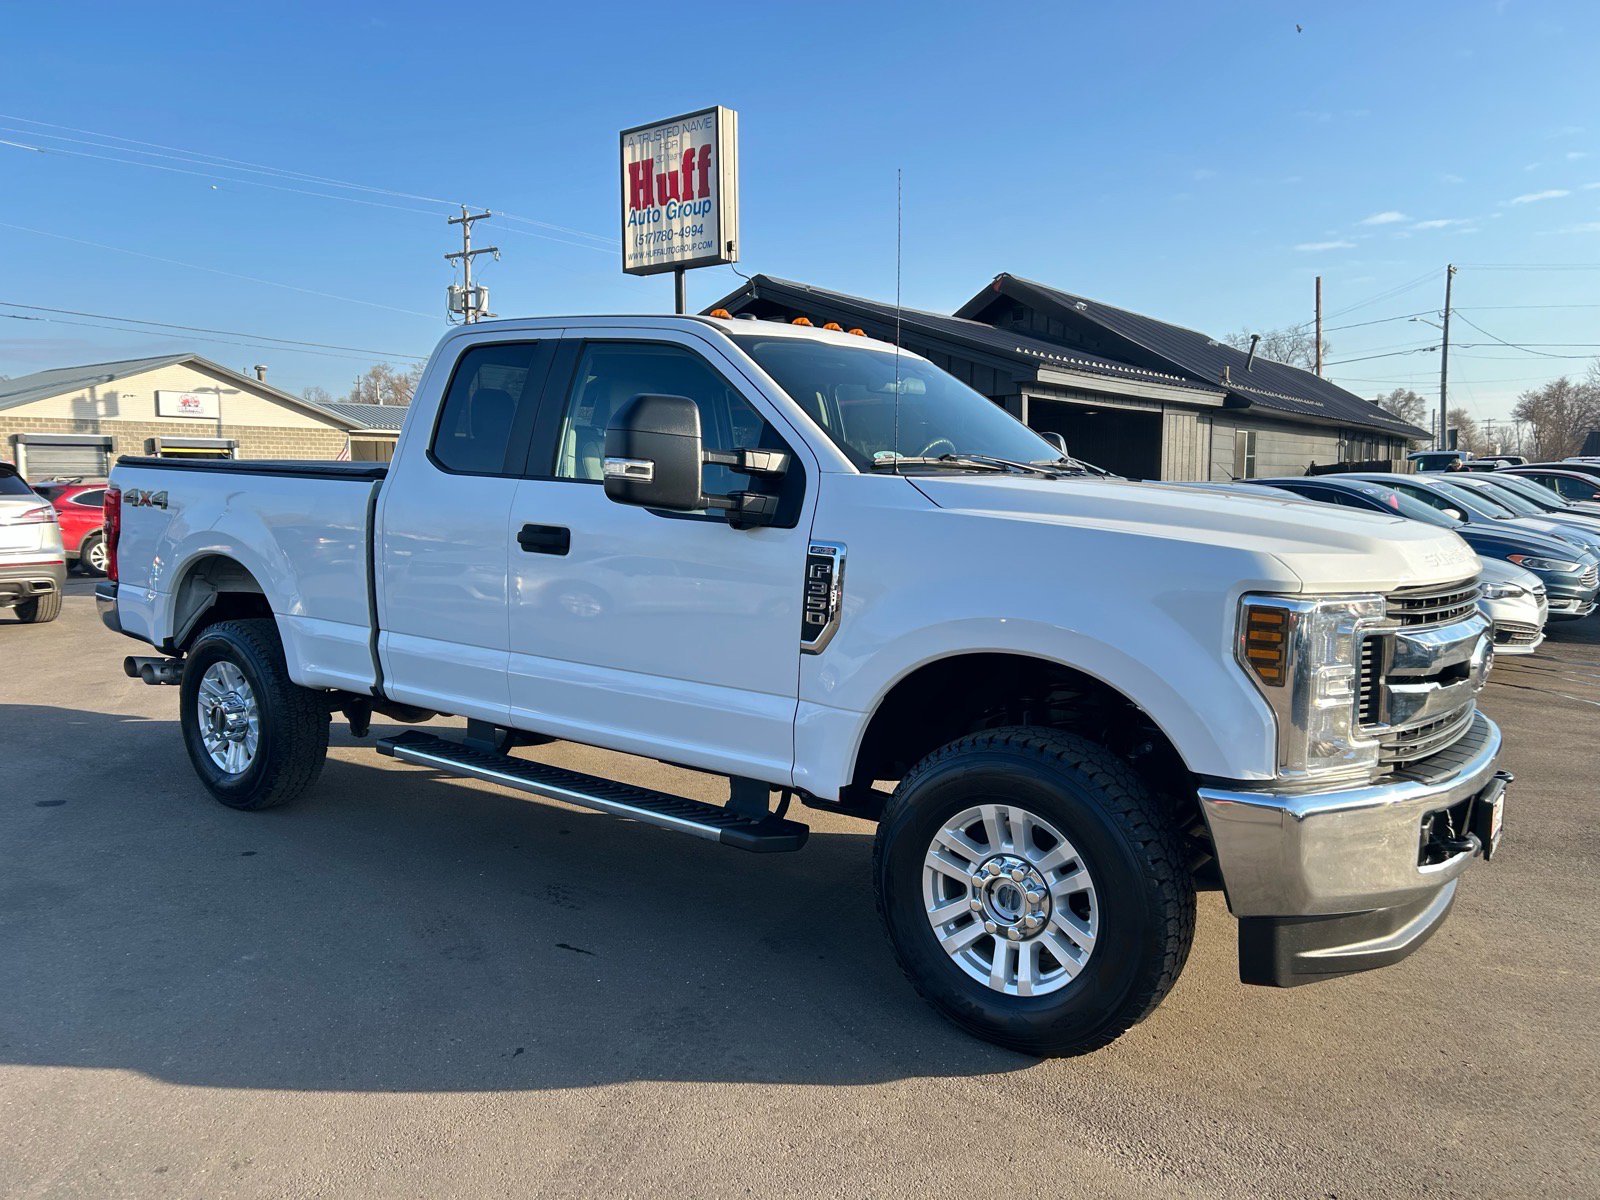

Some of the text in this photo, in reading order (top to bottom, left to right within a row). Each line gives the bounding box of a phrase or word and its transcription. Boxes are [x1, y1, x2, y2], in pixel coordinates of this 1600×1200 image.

[628, 116, 712, 148] A TRUSTED NAME
[659, 140, 679, 150] FOR
[628, 144, 712, 211] Huff
[628, 199, 712, 227] Auto Group
[635, 223, 704, 247] (517)780-4994
